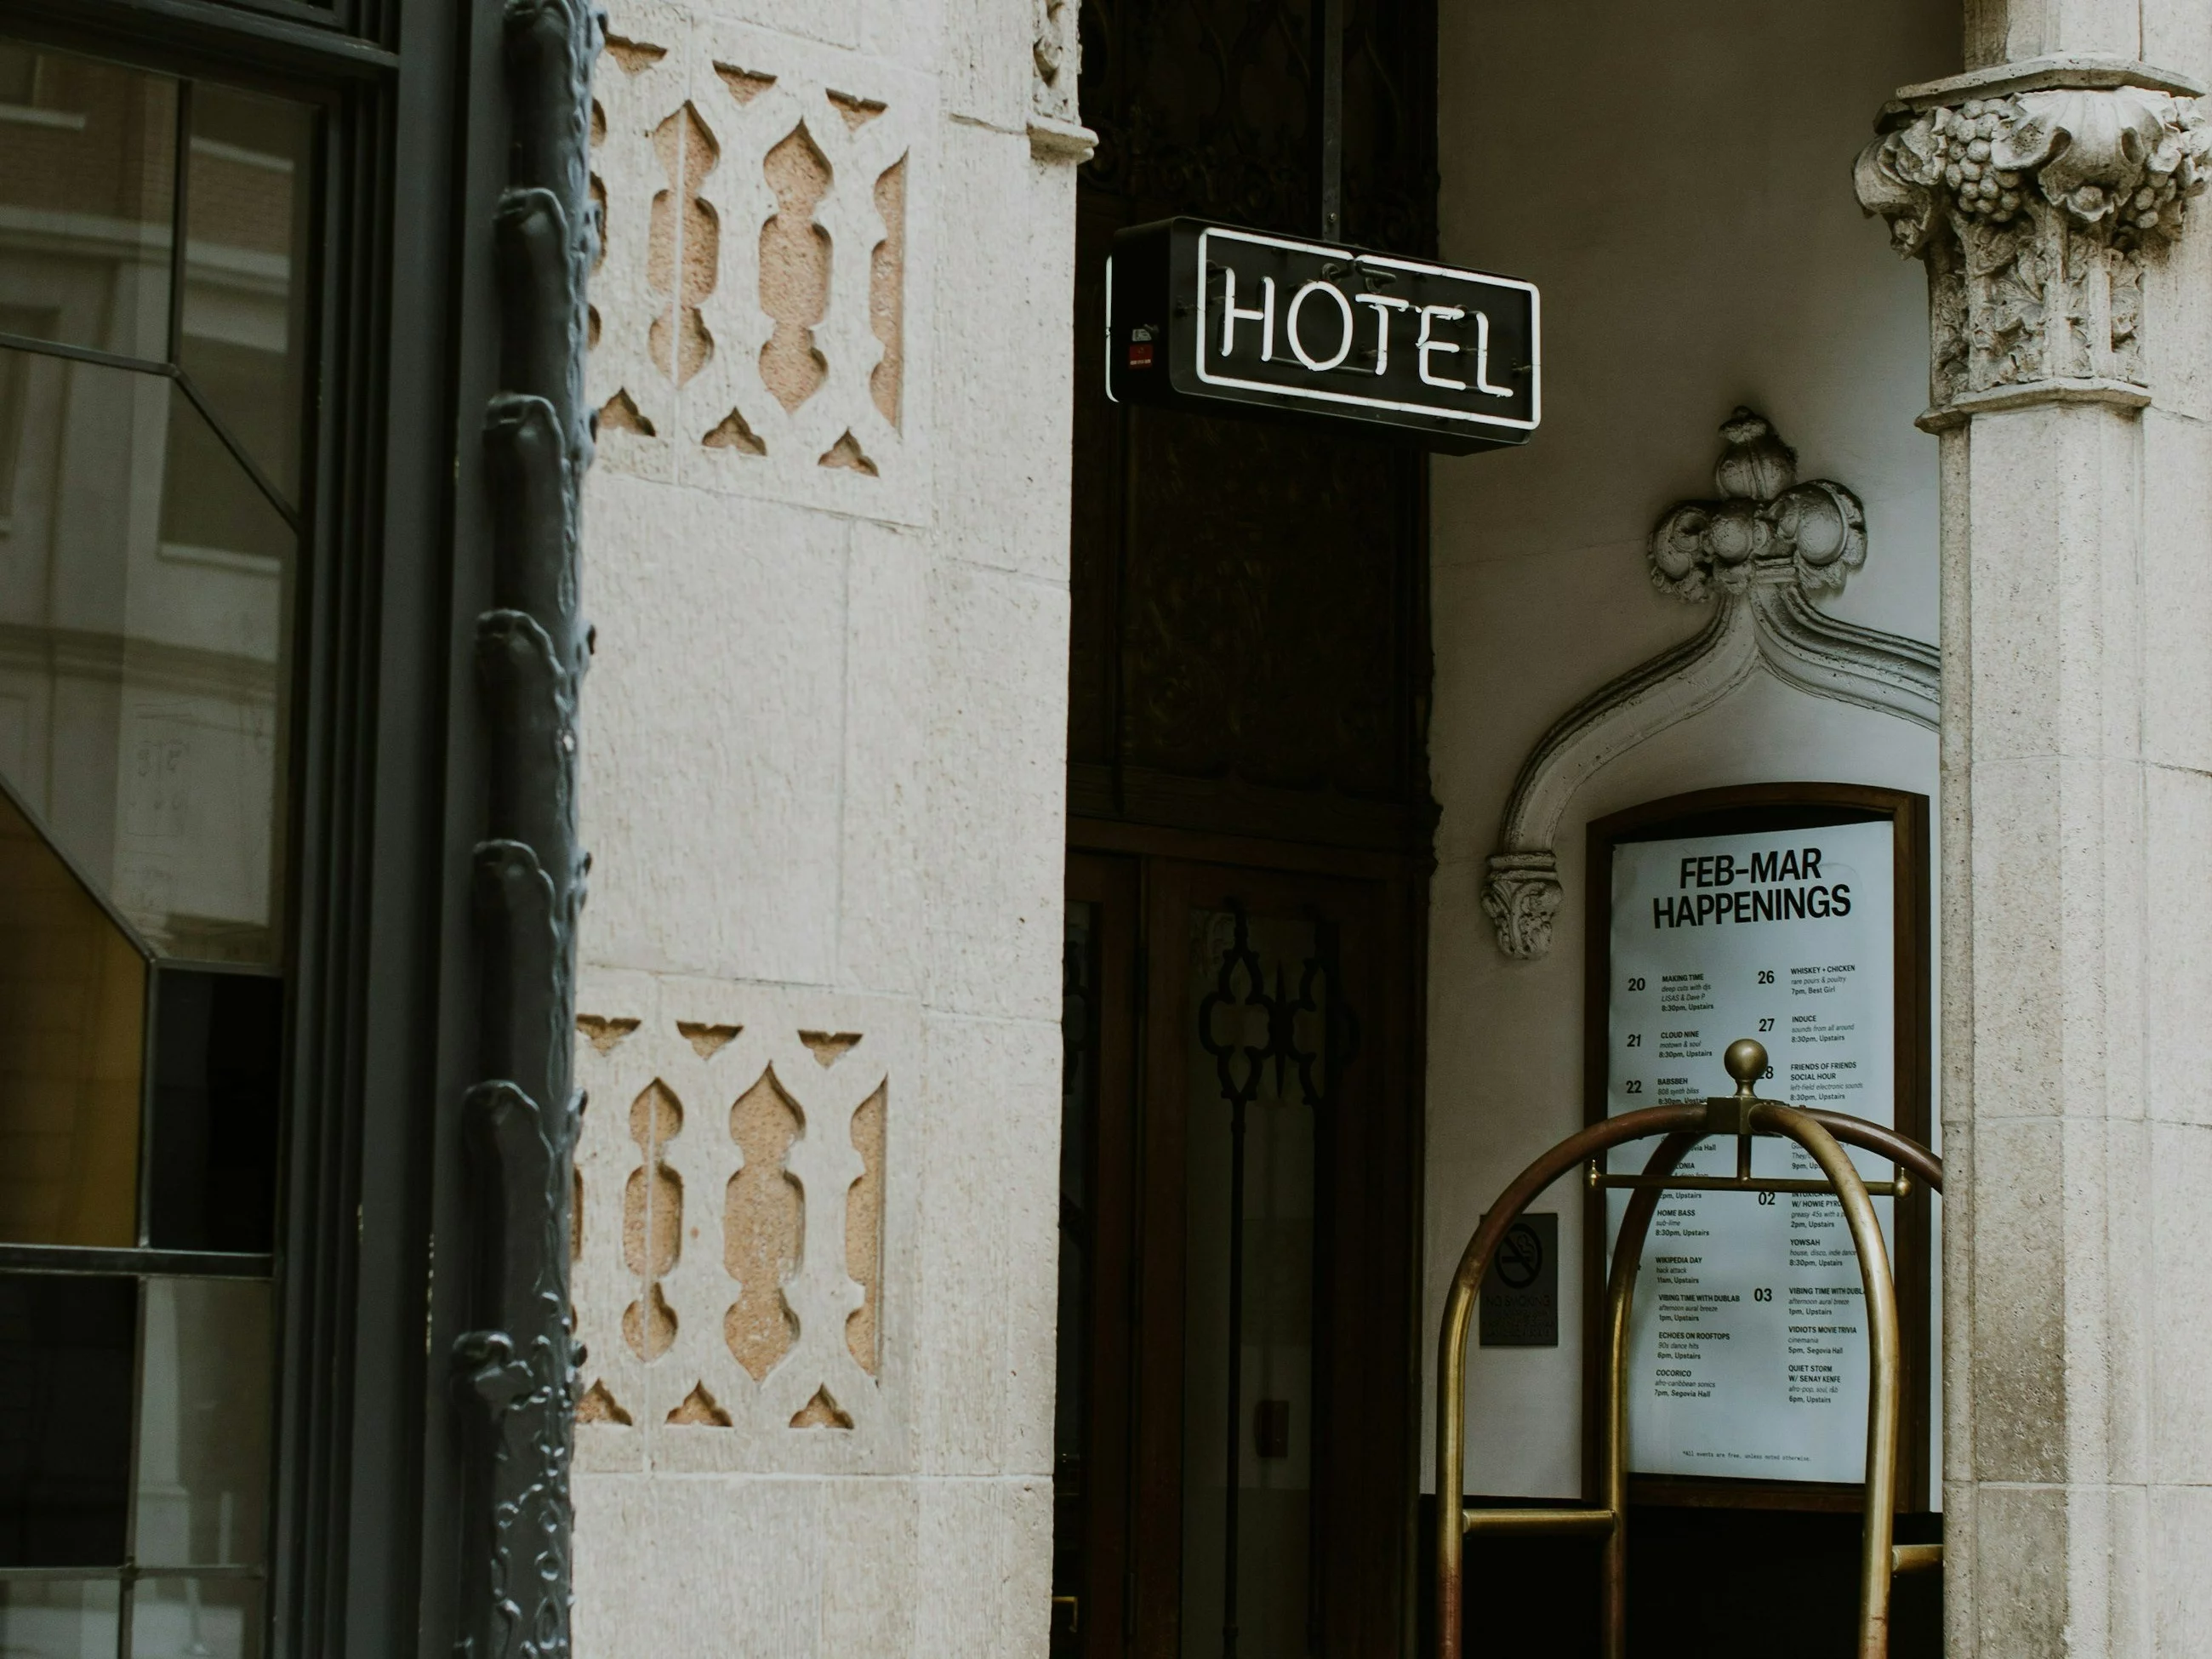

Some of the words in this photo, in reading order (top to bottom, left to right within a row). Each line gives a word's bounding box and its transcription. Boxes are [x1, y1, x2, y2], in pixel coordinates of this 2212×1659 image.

[1221, 265, 1514, 398] HOTEL
[1679, 847, 1821, 889] FEB-MAR
[1653, 883, 1851, 929] HAPPENINGS
[1791, 966, 1821, 975] WHISKEY
[1827, 965, 1856, 973] CHICKEN
[1662, 974, 1688, 983] MAKING
[1758, 971, 1775, 984] 26
[1827, 976, 1846, 984] poultry
[1628, 978, 1645, 991] 20
[1688, 1003, 1714, 1012] Upstairs
[1759, 1018, 1776, 1032] 27
[1627, 1035, 1641, 1047] 21
[1690, 1040, 1702, 1048] soul
[1831, 1061, 1857, 1069] FRIENDS
[1626, 1080, 1642, 1093] 22
[1816, 1082, 1844, 1091] electronic
[1759, 1192, 1776, 1206] 02
[1754, 1288, 1772, 1303] 03
[1674, 1352, 1702, 1360] Upstairs
[1806, 1347, 1832, 1355] Segovia
[1671, 1389, 1696, 1398] Segovia
